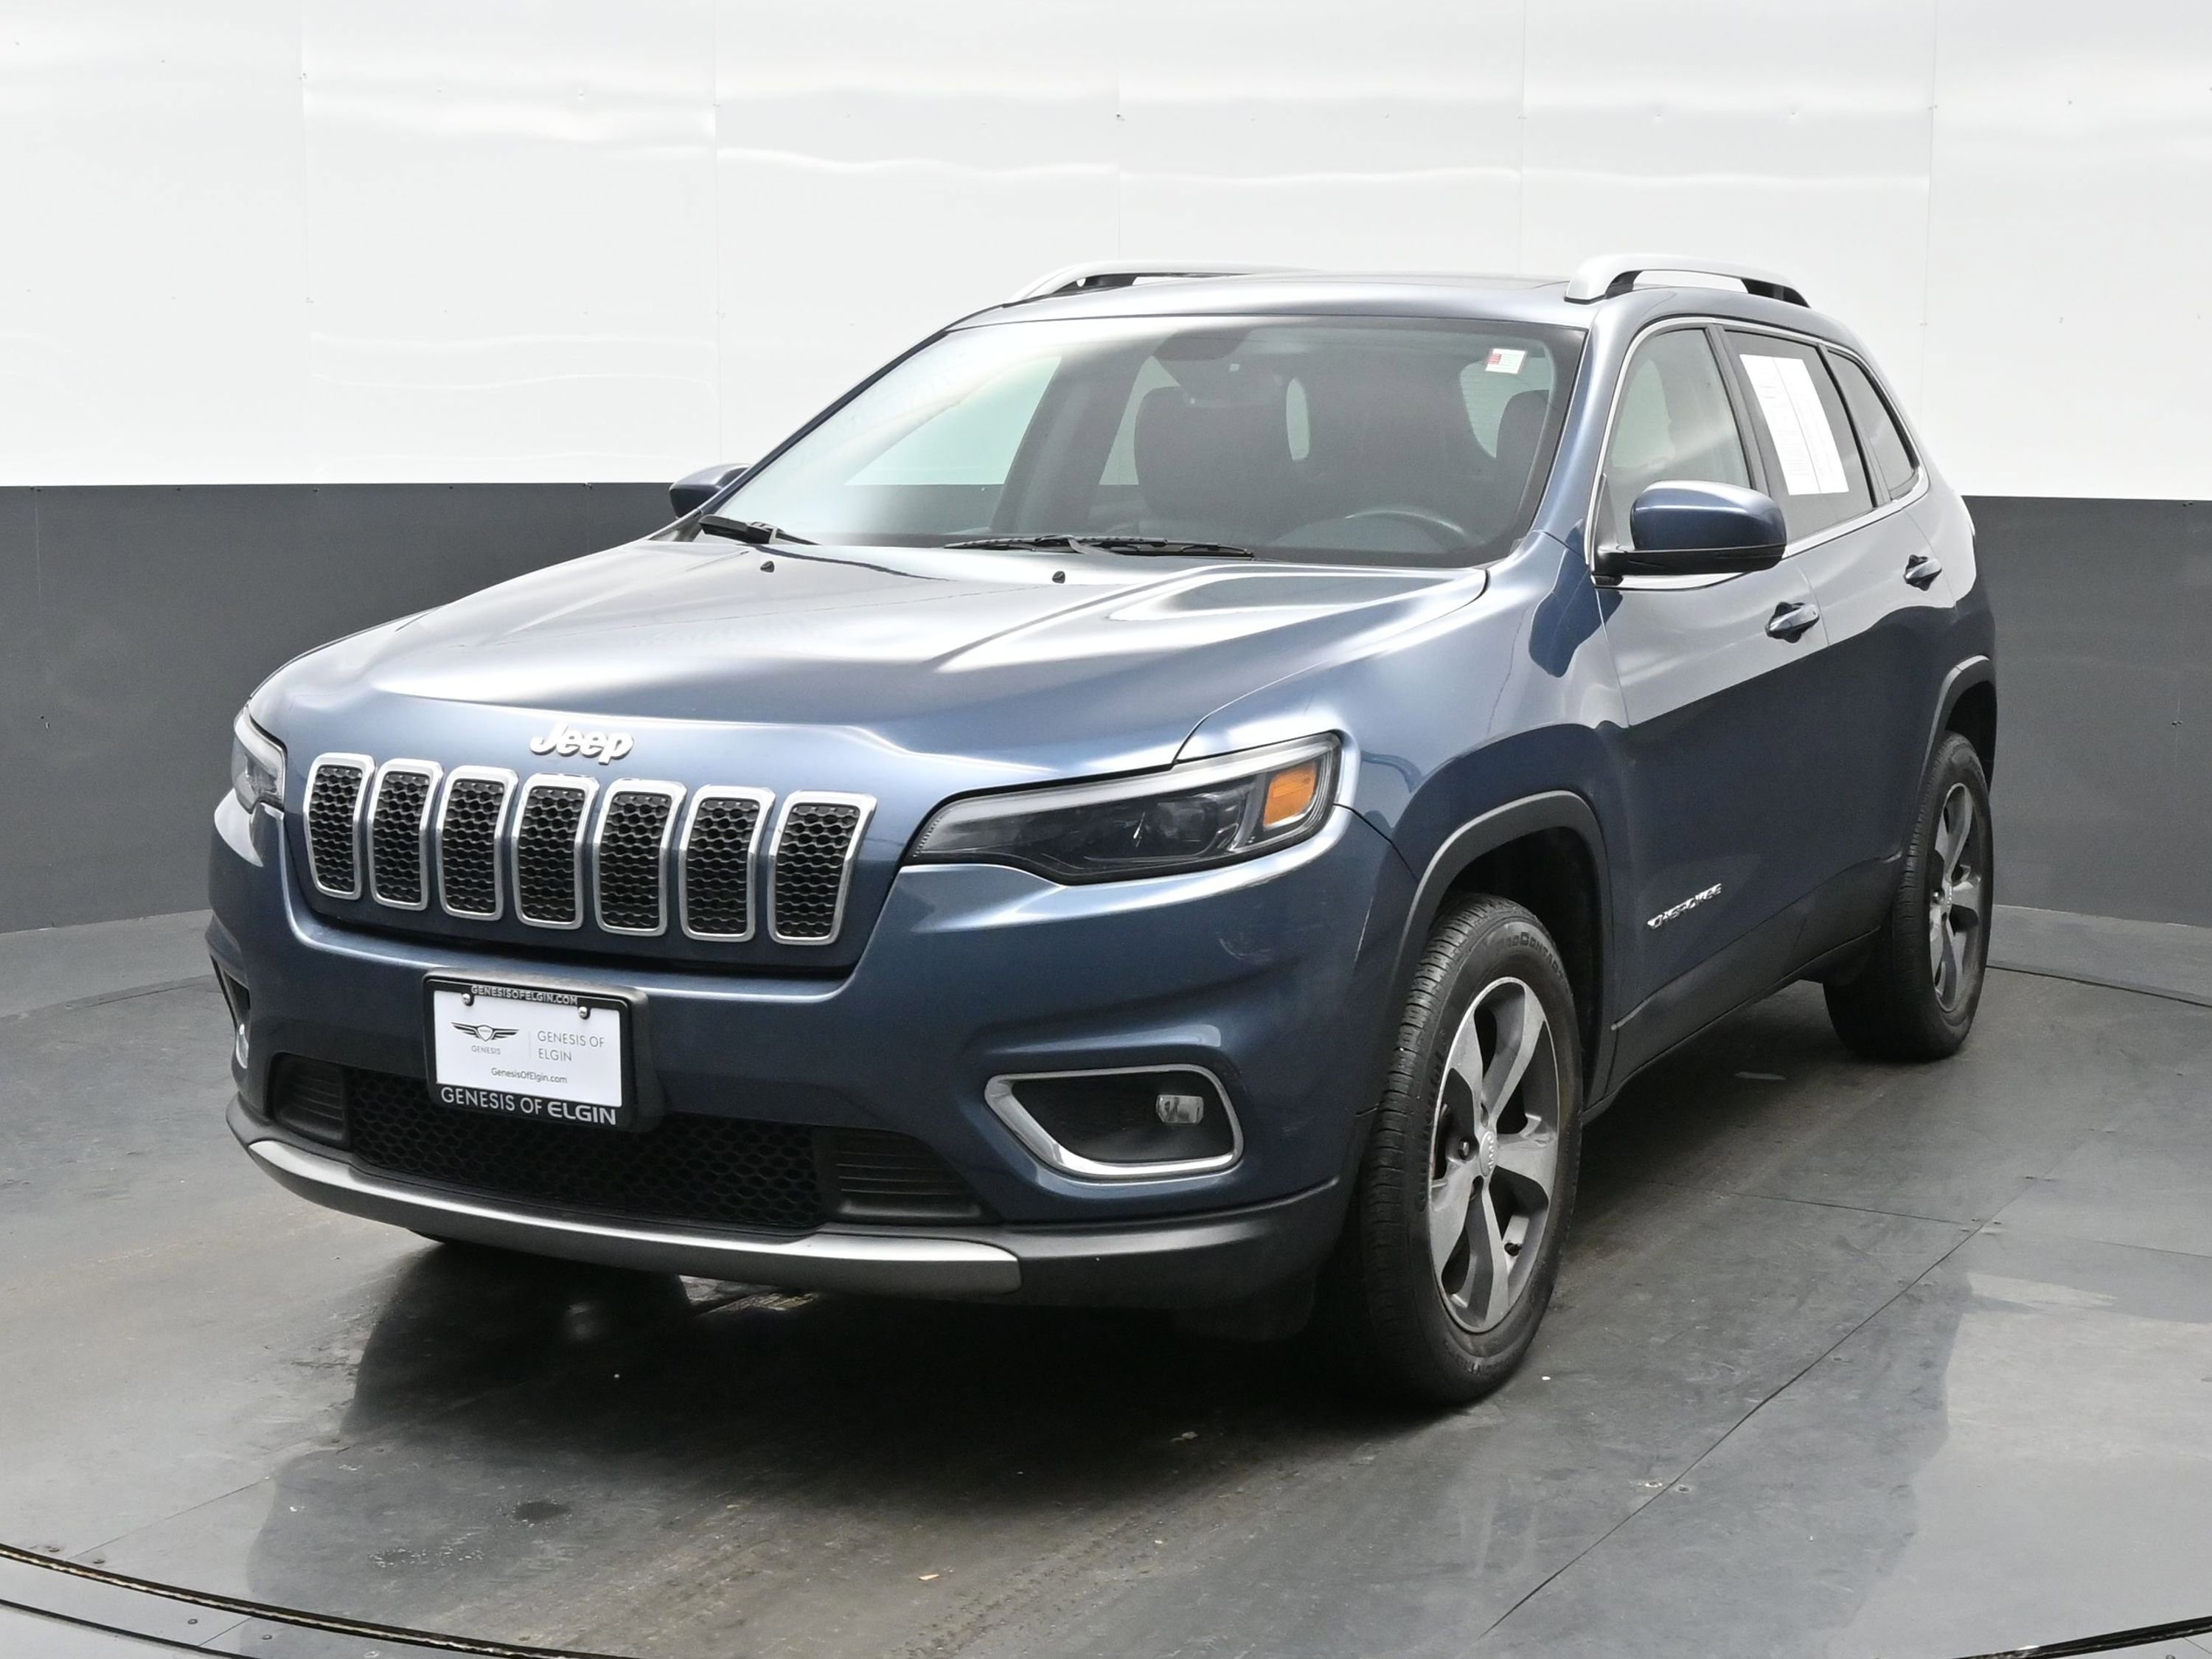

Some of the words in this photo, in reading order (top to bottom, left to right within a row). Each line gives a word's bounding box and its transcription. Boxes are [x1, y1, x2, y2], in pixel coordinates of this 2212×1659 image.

[529, 722, 634, 766] Jeep
[470, 984, 578, 1006] GENESISOFELGIN.COM
[538, 1030, 587, 1047] GENESIS
[589, 1035, 605, 1048] OF
[470, 1045, 501, 1055] GENESIS
[538, 1048, 572, 1062] ELGIN
[491, 1067, 568, 1084] GenesisOfElgin.com
[441, 1086, 515, 1112] GENESIS
[521, 1097, 543, 1116] OF
[547, 1101, 617, 1126] ELGIN
